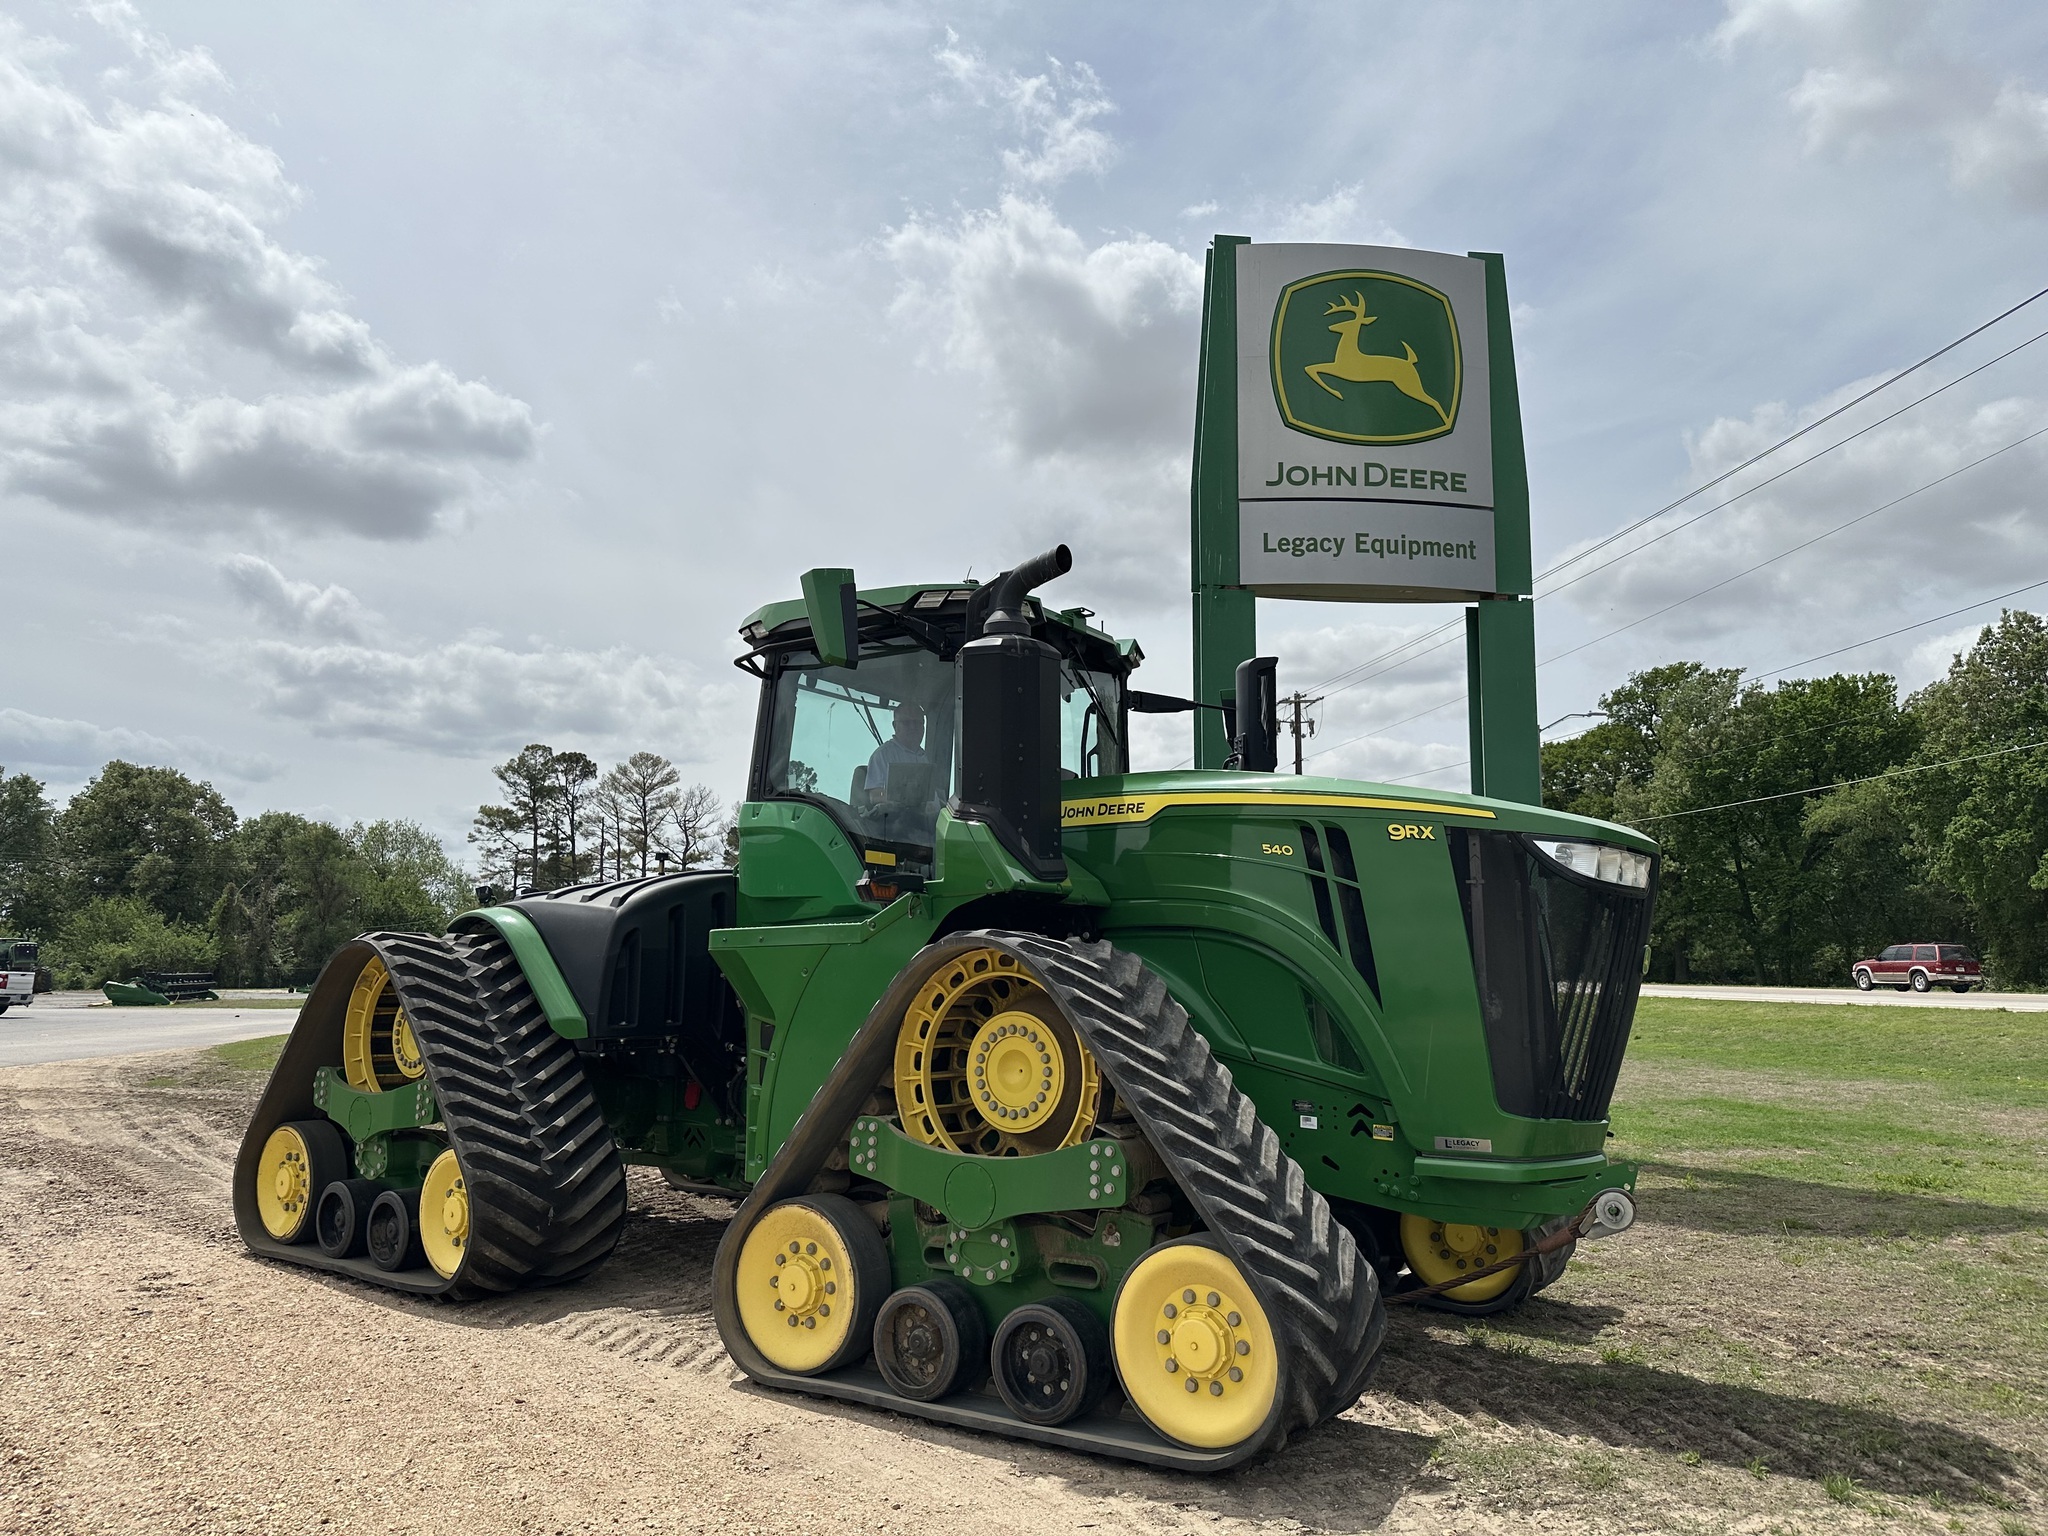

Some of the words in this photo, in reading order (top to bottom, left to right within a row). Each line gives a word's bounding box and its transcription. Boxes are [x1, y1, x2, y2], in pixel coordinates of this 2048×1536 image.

[1265, 461, 1357, 487] JOHN
[1363, 461, 1468, 493] DEERE
[1262, 532, 1346, 558] Legacy
[1355, 532, 1477, 560] Equipment
[1061, 806, 1095, 819] JOHN
[1097, 802, 1146, 816] DEERE
[1387, 823, 1436, 841] 9RX
[1261, 843, 1294, 856] 540
[1452, 1139, 1480, 1147] LEGACY
